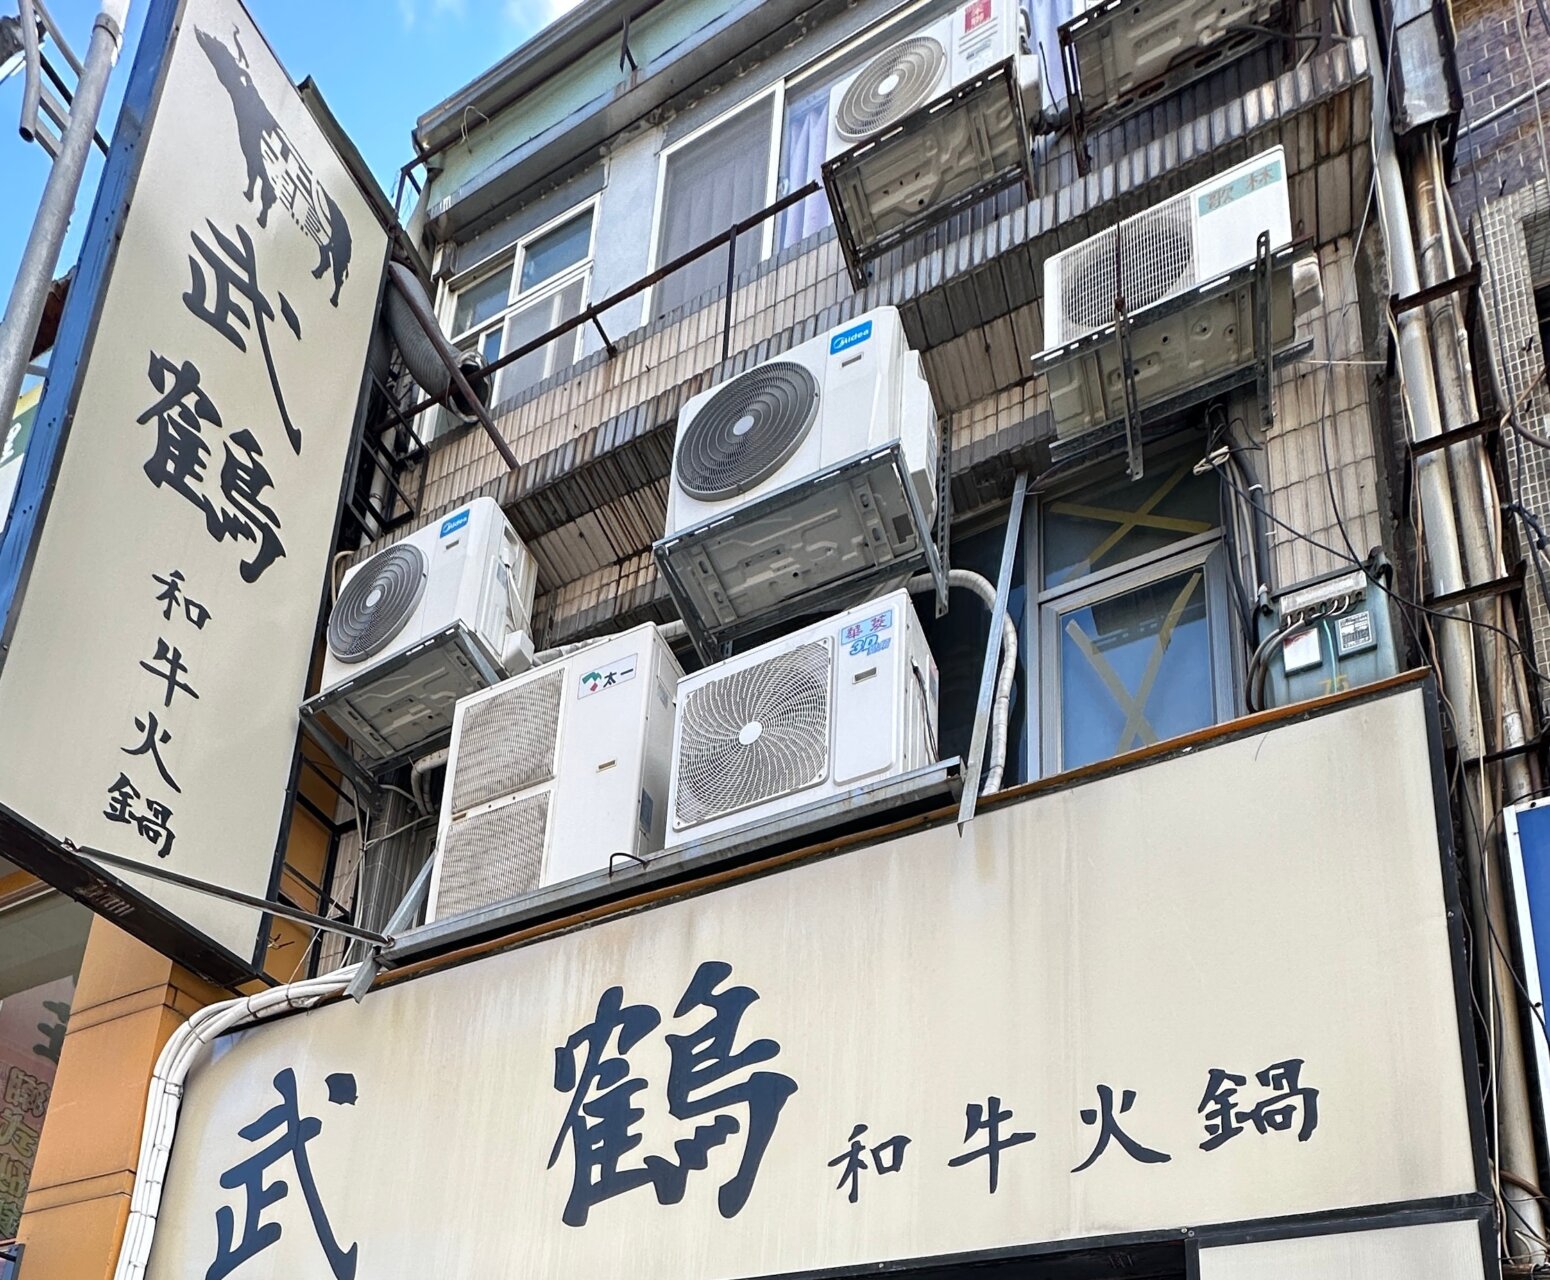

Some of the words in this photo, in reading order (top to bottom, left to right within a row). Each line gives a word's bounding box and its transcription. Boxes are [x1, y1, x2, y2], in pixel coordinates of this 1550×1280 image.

[137, 217, 302, 584] 武鶴
[833, 329, 869, 349] Midea
[103, 569, 211, 859] 和牛火鍋
[603, 667, 634, 688] 太一
[827, 1058, 1320, 1203] 和牛火鍋
